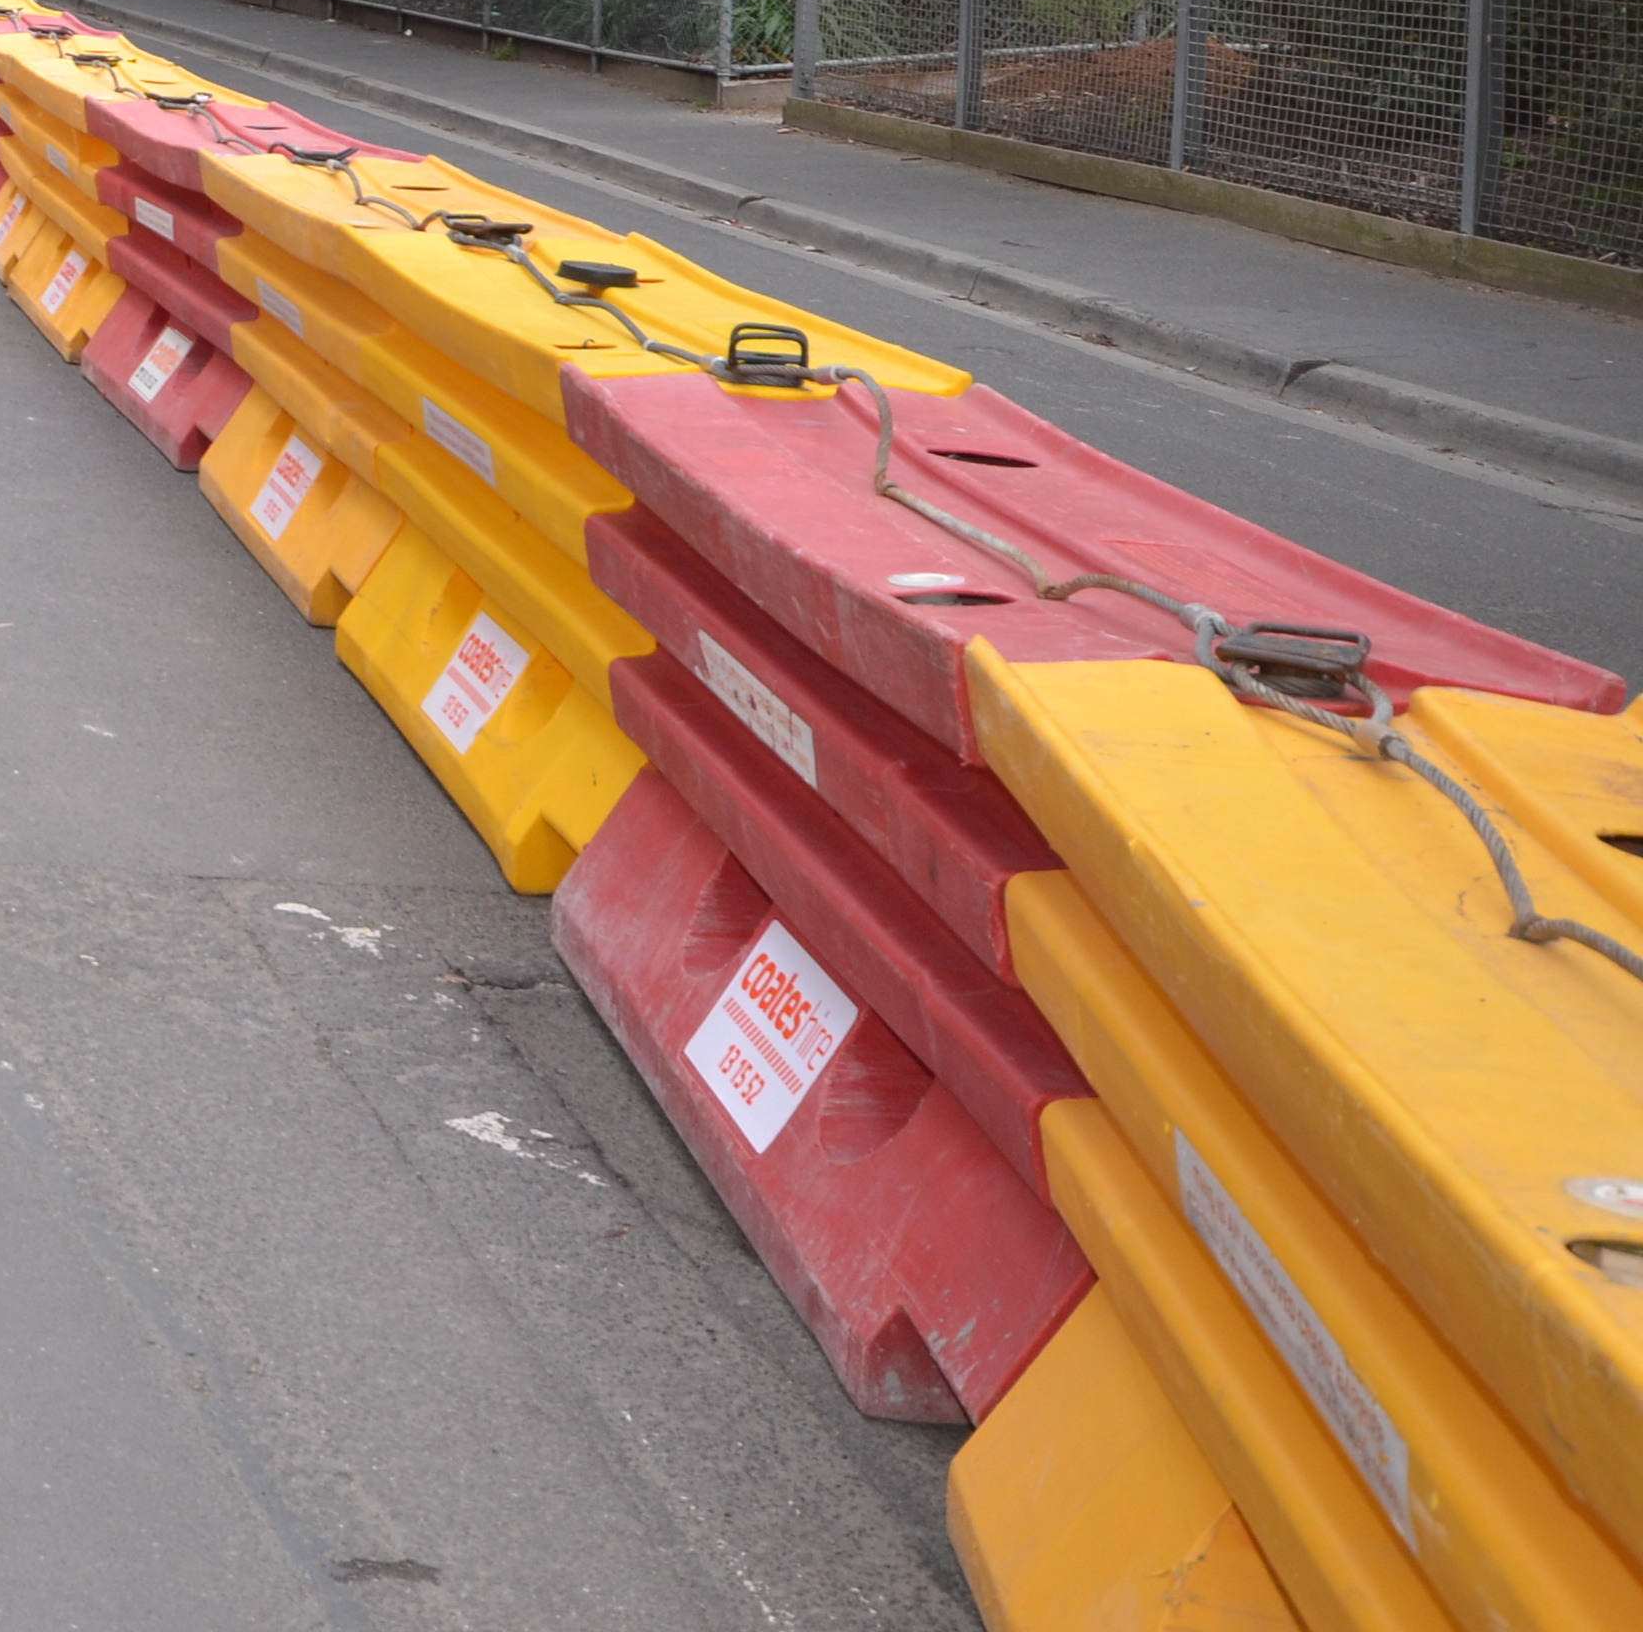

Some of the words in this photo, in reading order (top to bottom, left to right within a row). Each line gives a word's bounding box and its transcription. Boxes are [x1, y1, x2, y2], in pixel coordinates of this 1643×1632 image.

[741, 952, 812, 1040] coates
[790, 1000, 834, 1072] hire
[718, 1044, 741, 1074] 13
[731, 1059, 754, 1089] 15
[740, 1073, 766, 1106] 52
